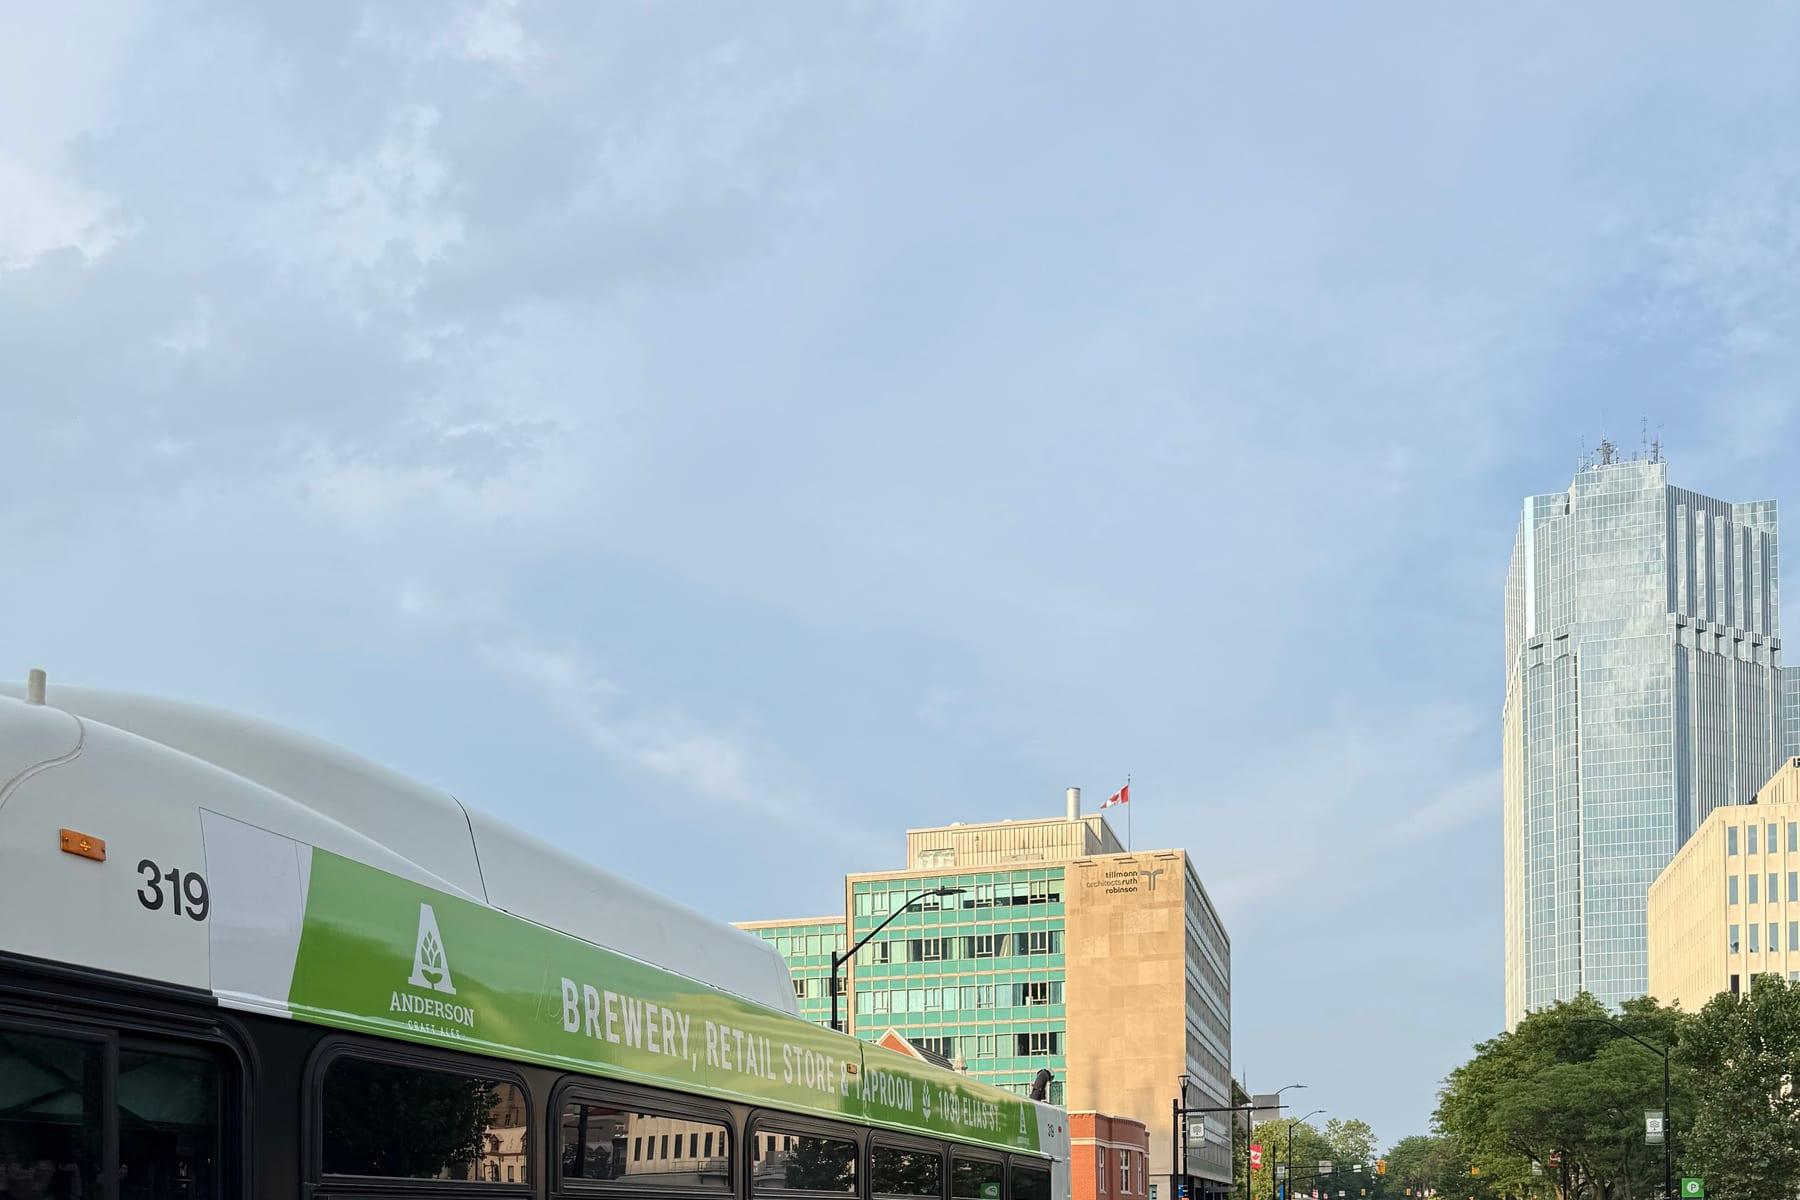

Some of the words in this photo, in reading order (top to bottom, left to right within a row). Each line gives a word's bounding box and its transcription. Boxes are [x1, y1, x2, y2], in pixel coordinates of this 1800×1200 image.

[136, 858, 210, 922] 319
[1105, 886, 1138, 894] robinson
[389, 991, 474, 1028] ANDERSON
[561, 977, 697, 1073] BREWERY,
[705, 1020, 776, 1080] RETAIL
[783, 1043, 834, 1094] STORE
[840, 1060, 849, 1097] &
[938, 1091, 960, 1124] 1030
[963, 1097, 988, 1130] ELIAS
